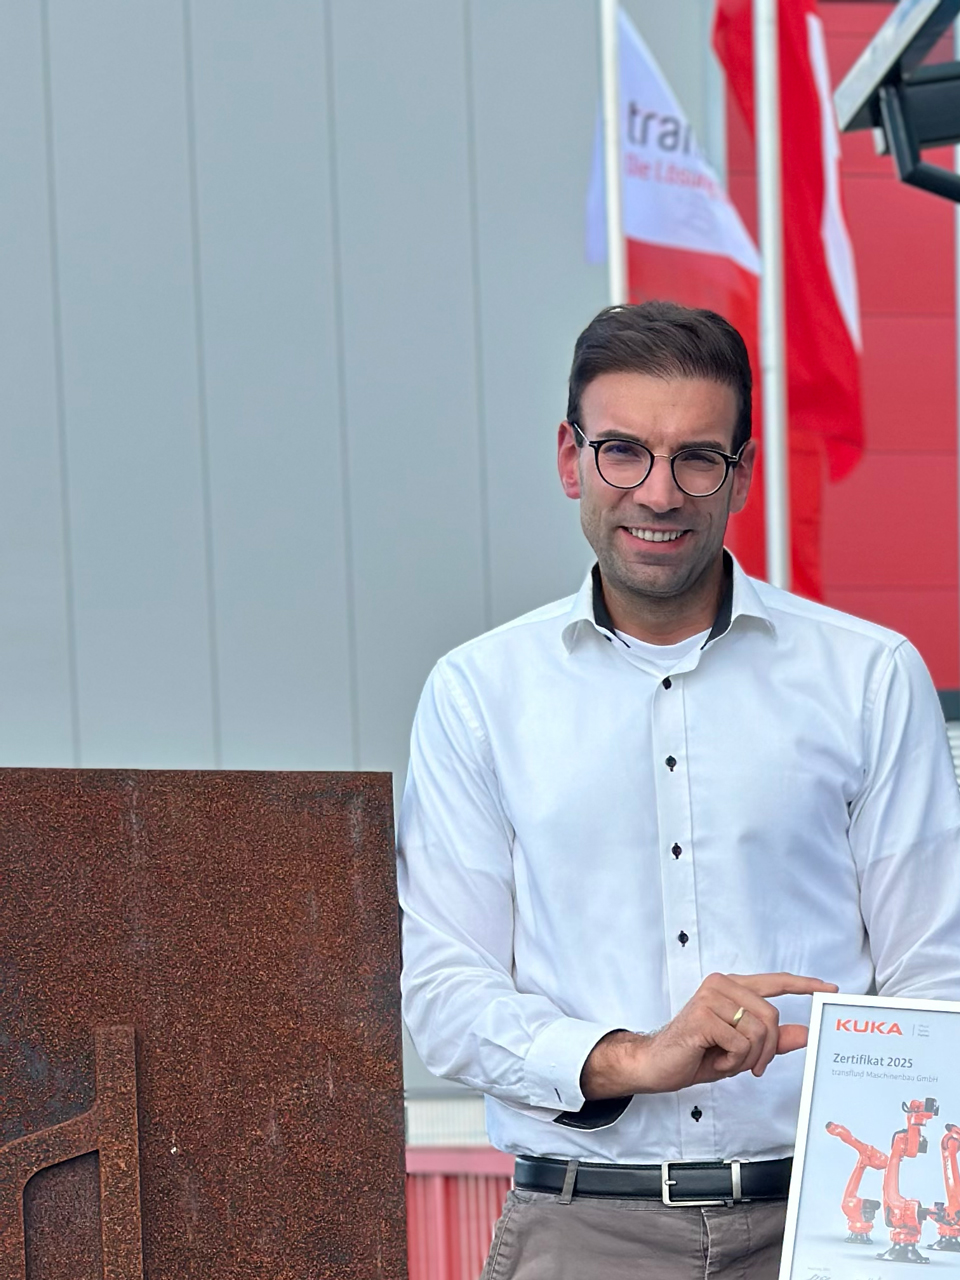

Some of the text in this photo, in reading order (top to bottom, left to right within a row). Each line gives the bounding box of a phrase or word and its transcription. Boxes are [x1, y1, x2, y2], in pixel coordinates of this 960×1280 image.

[836, 1018, 903, 1036] KUKA
[833, 1053, 913, 1069] Zertifikat 2025
[831, 1069, 939, 1083] transfluid Maschinenbau GmbH
